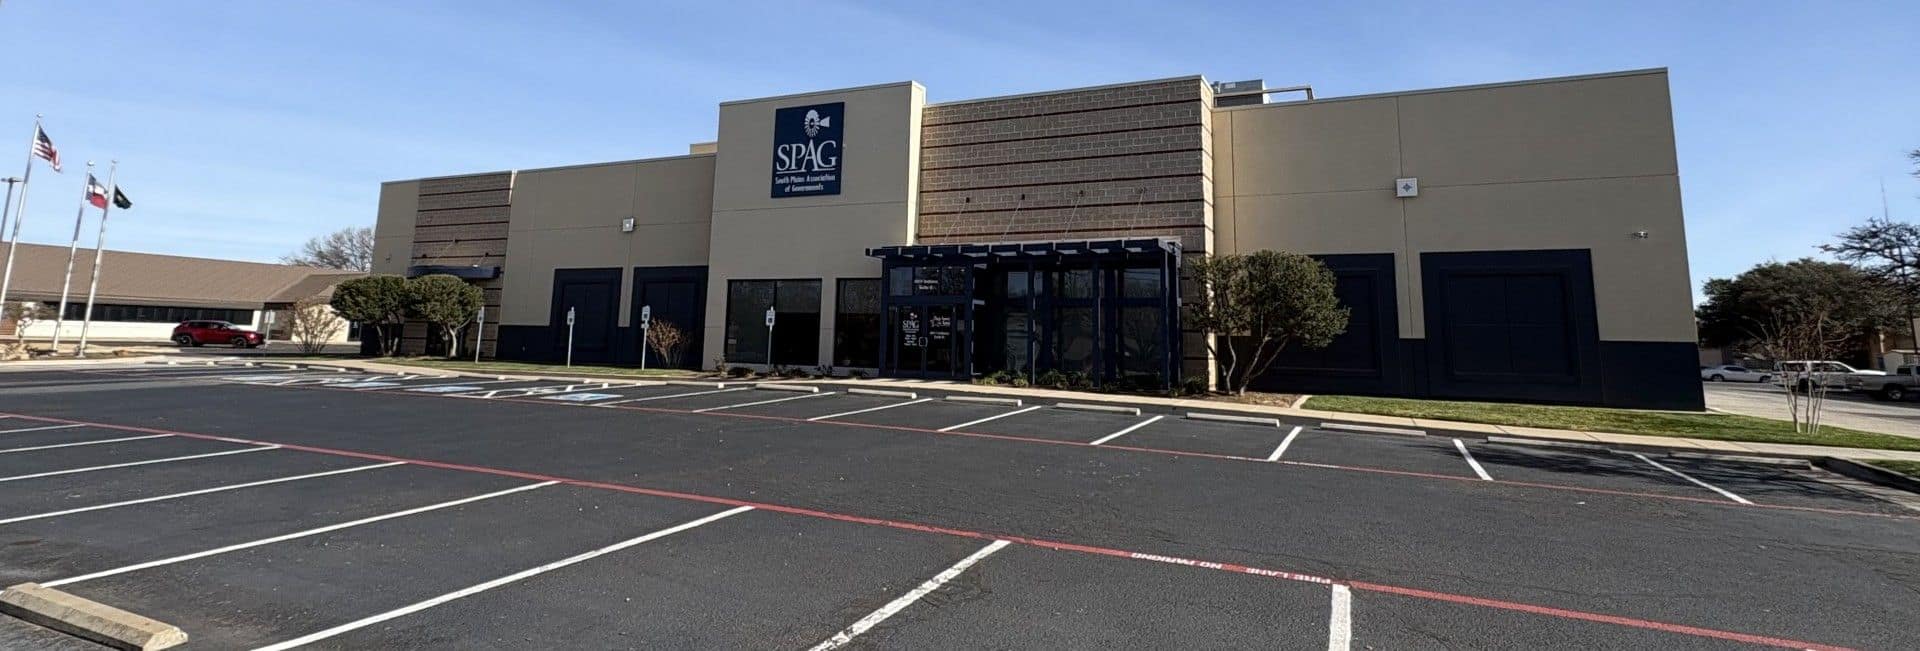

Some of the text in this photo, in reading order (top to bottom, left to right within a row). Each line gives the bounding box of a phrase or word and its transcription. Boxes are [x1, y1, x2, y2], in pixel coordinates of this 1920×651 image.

[776, 139, 837, 171] SPAG
[775, 174, 835, 184] South Plains Association
[792, 183, 824, 192] Governments
[1131, 552, 1331, 584] FIRE LANE NO PARKING
